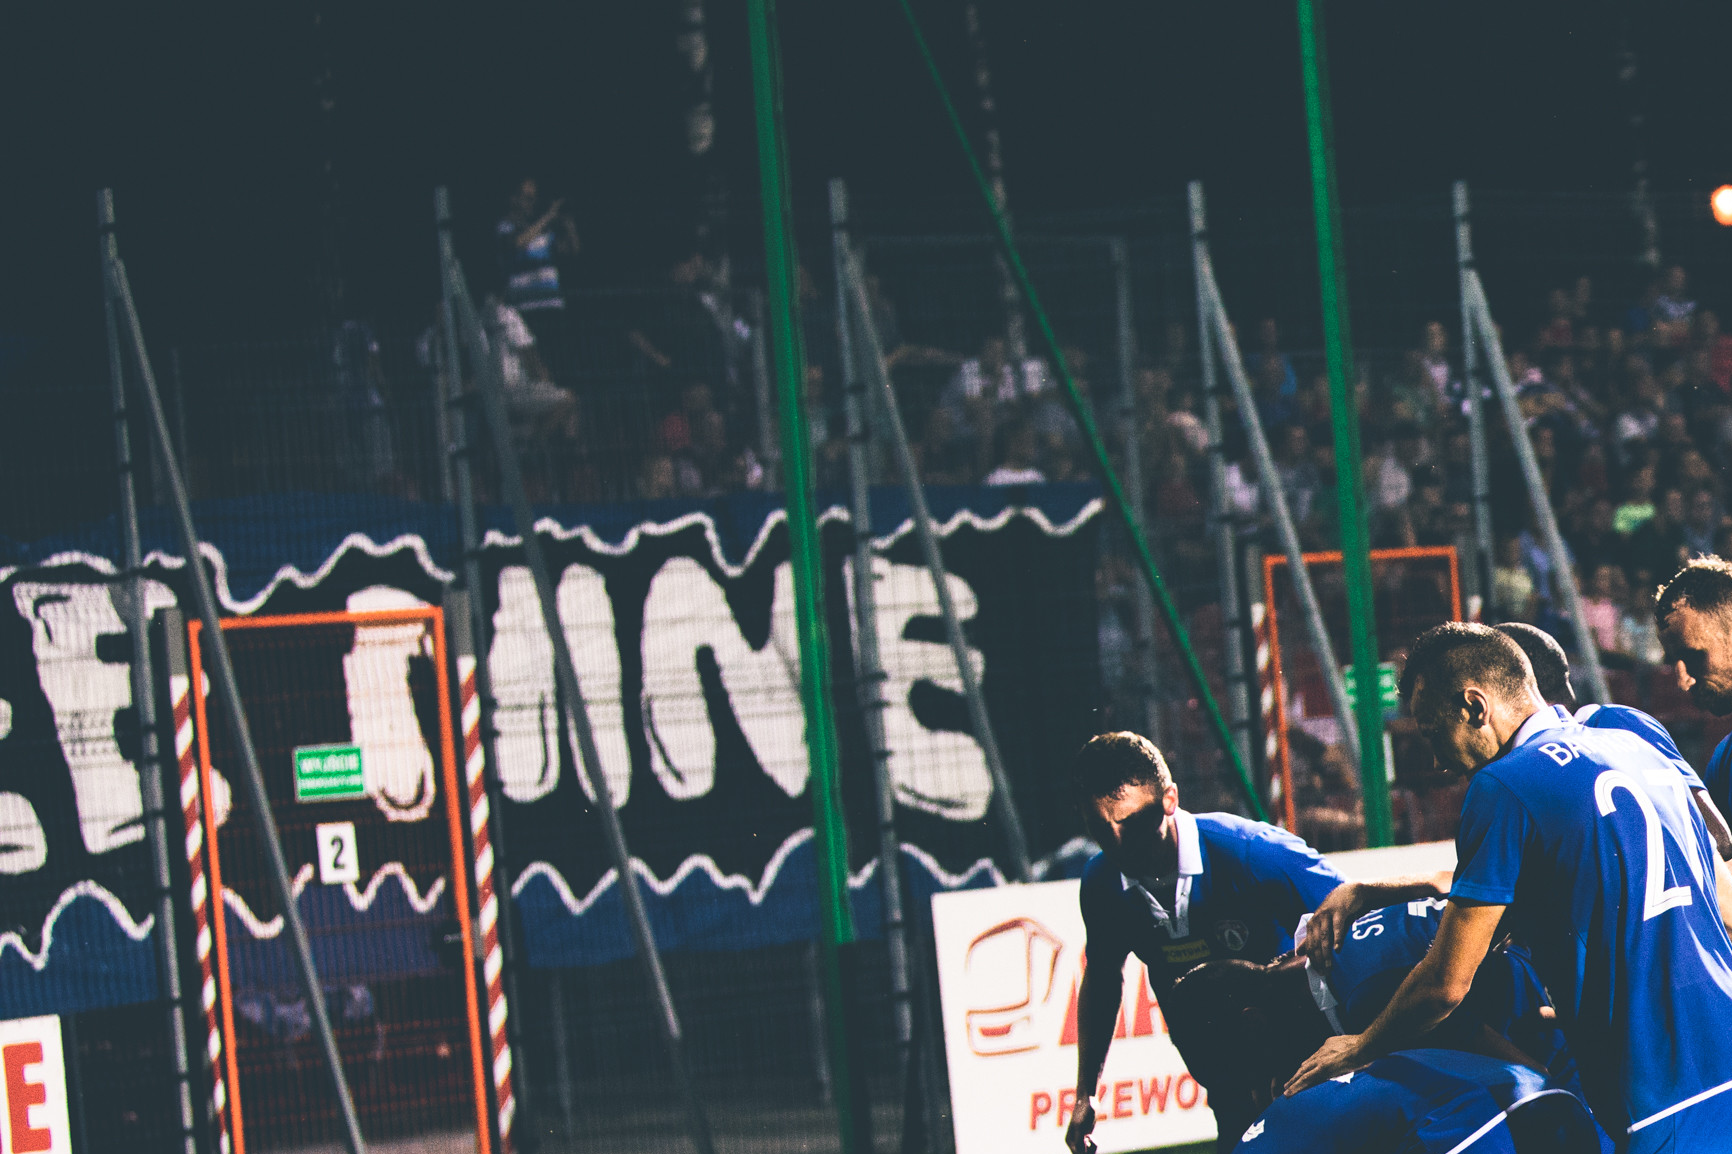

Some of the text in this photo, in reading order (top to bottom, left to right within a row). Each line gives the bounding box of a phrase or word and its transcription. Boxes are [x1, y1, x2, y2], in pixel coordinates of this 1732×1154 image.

[331, 835, 346, 870] 2
[1594, 768, 1704, 921] 27
[0, 1040, 52, 1154] E
[1029, 1072, 1210, 1130] PRZEWO
